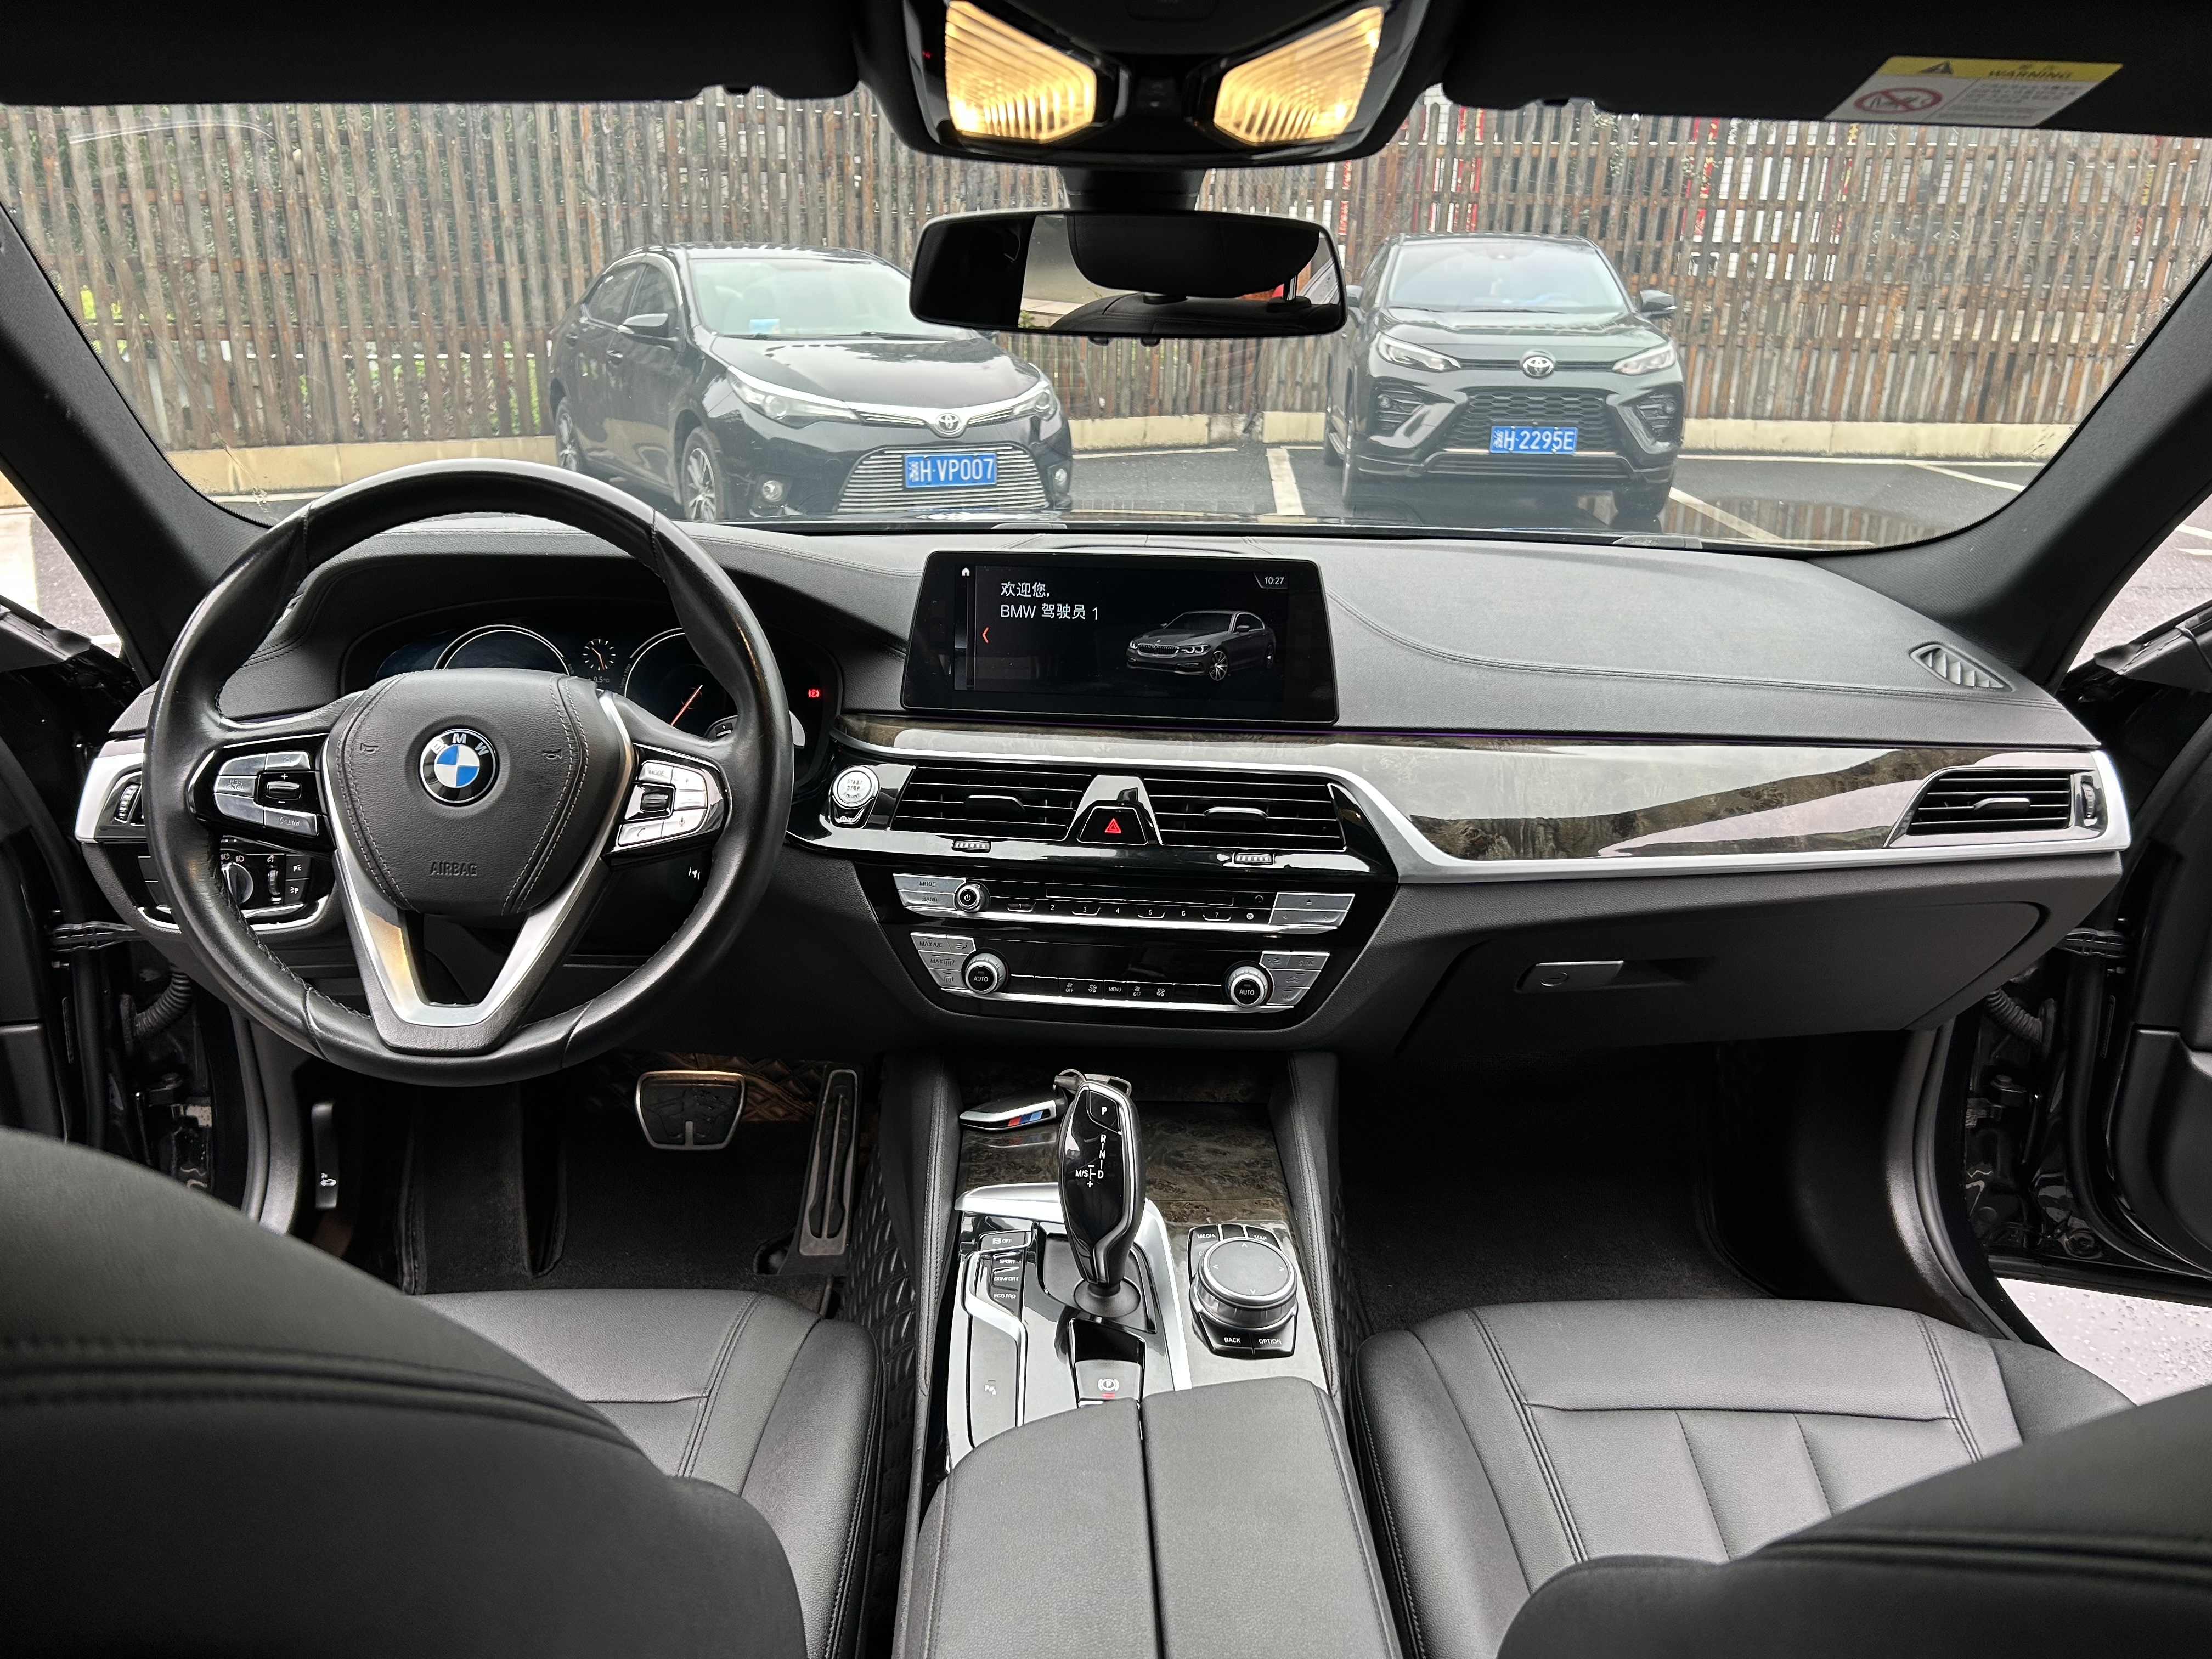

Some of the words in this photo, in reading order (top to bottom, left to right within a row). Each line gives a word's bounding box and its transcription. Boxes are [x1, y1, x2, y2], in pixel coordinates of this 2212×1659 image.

[1988, 69, 2072, 79] WARNING
[1264, 576, 1284, 585] 10:27
[1001, 605, 1036, 618] BMW
[1041, 603, 1086, 620] 驾驶员
[1092, 607, 1098, 620] 1
[430, 733, 490, 757] BMW
[430, 861, 477, 877] AIRBAG
[1101, 1106, 1108, 1115] P
[1101, 1134, 1107, 1143] R
[1099, 1150, 1106, 1159] N
[1075, 1169, 1088, 1178] M/S
[1098, 1170, 1104, 1179] D
